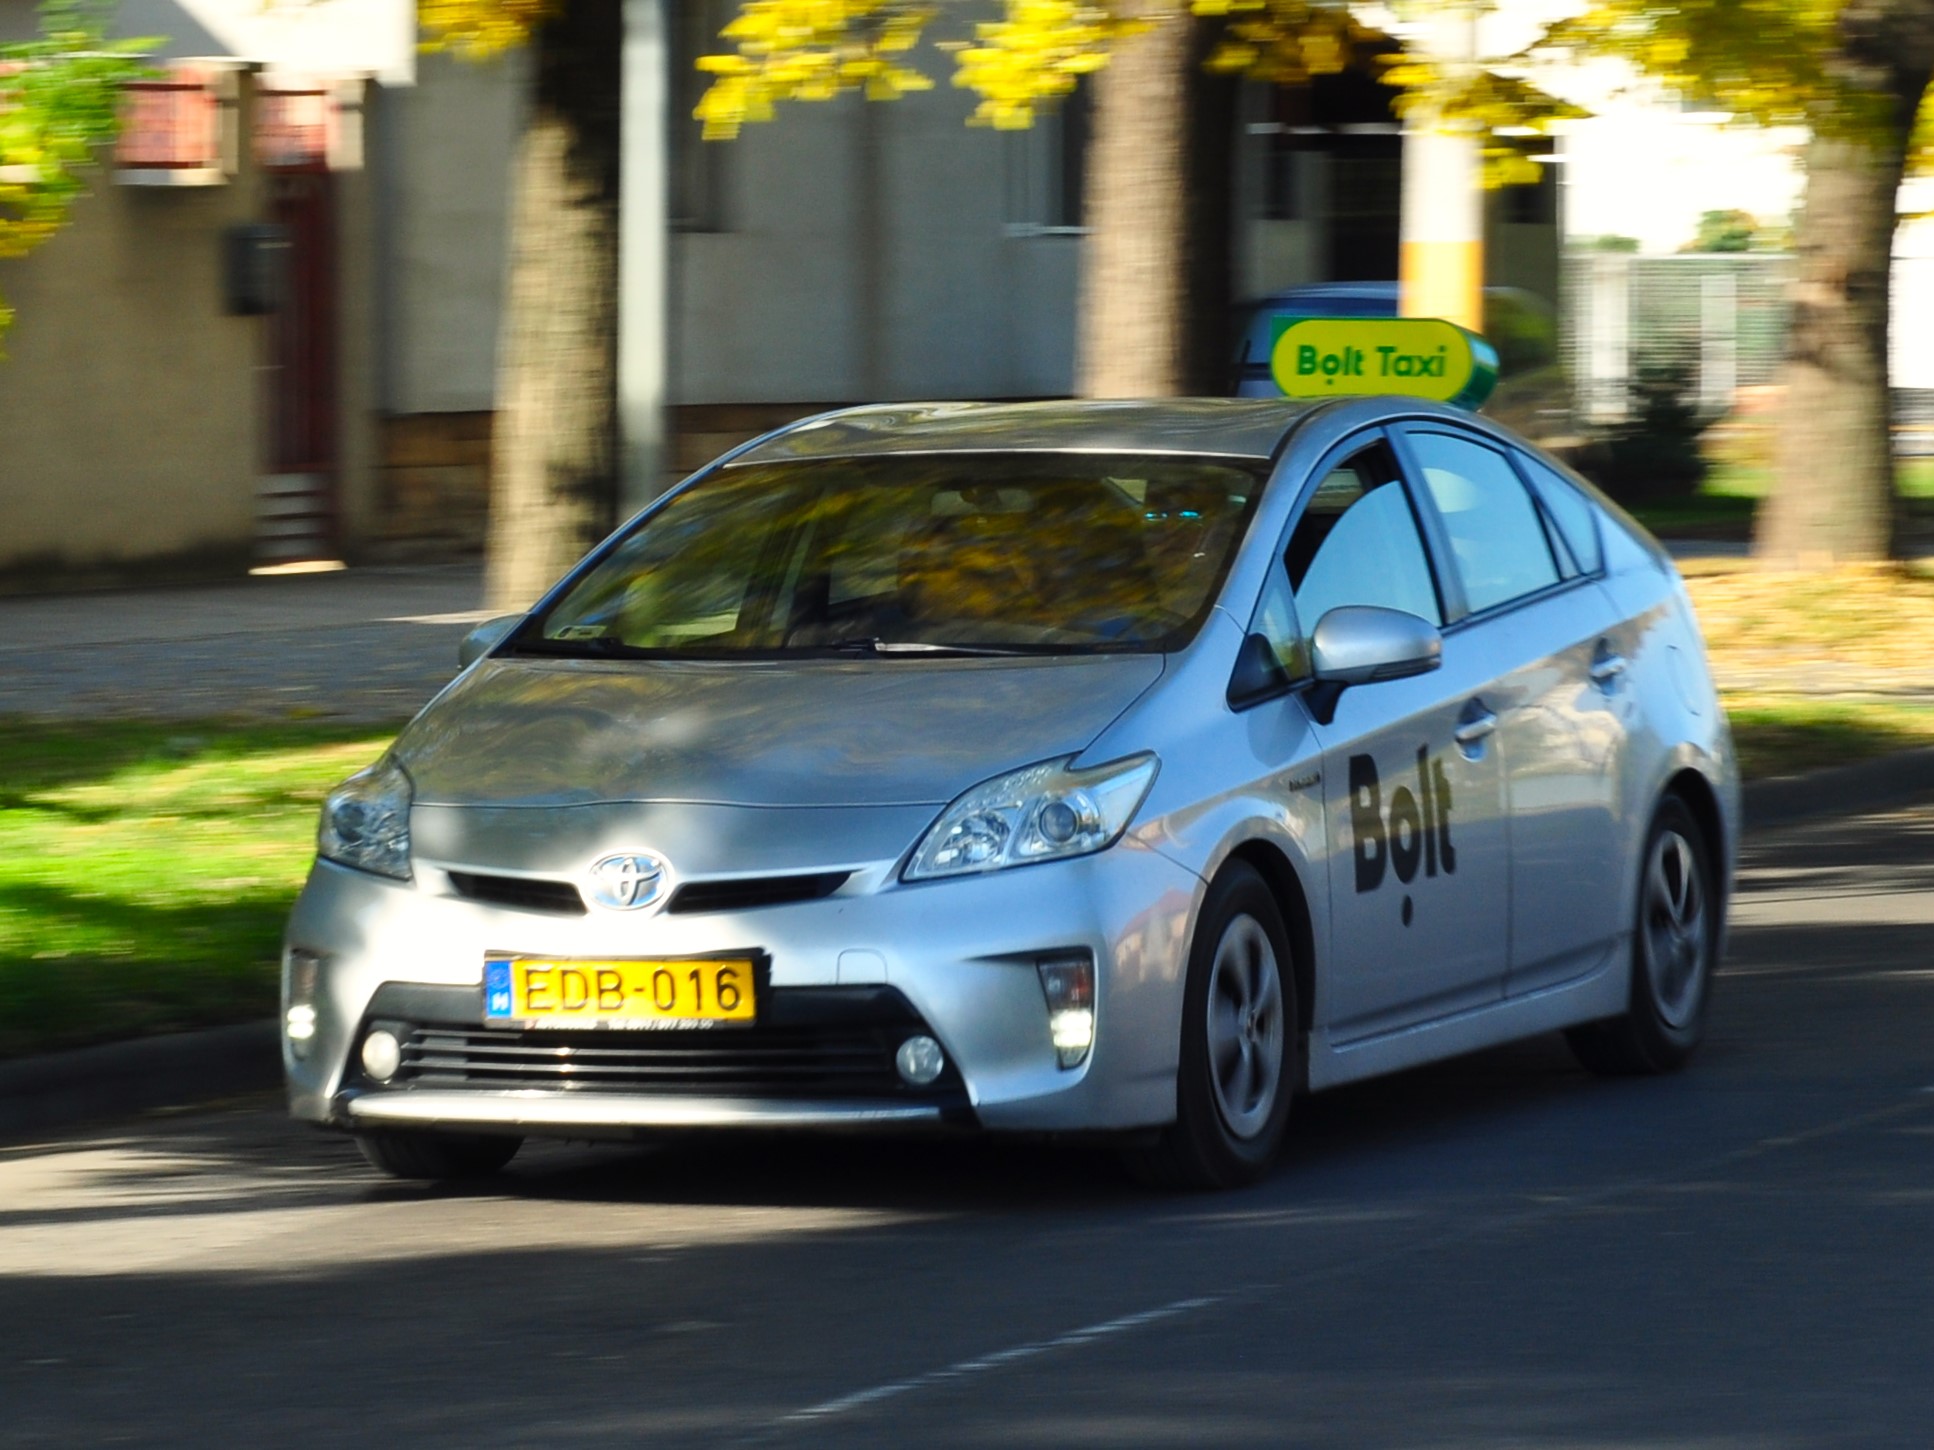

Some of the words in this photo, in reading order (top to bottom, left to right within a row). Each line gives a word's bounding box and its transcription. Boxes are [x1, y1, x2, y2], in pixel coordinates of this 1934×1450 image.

[1297, 345, 1364, 385] Bolt
[1376, 346, 1446, 377] Taxi
[1349, 744, 1456, 927] Bolt
[525, 966, 741, 1011] EDB-016
